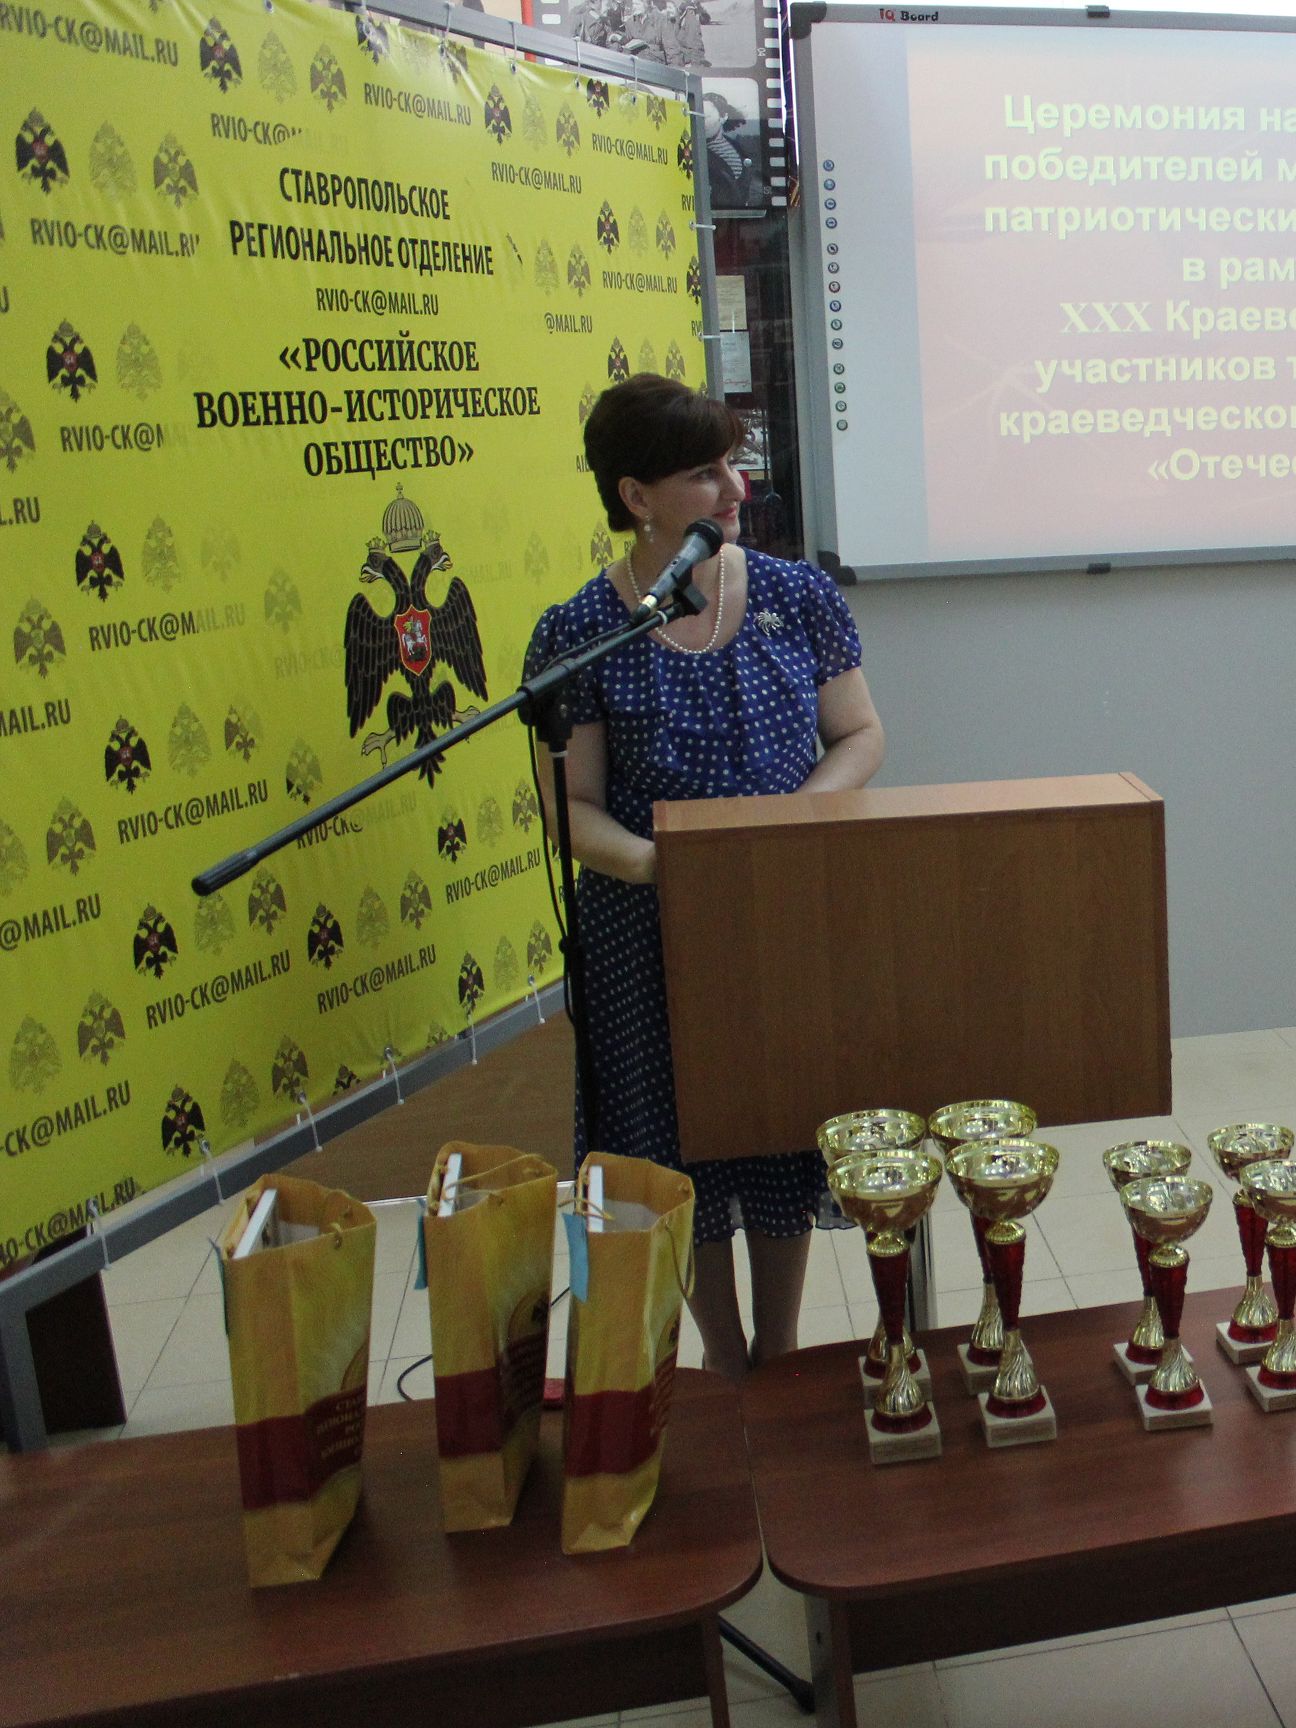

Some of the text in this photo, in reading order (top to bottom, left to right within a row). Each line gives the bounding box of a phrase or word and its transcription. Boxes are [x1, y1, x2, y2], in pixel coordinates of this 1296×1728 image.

[0, 2, 179, 68] RVIO-CK@MAIL.RU
[900, 10, 938, 21] Board
[364, 82, 472, 127] RVIO-CK@MAIL.RU
[1004, 94, 1245, 138] Церемония
[591, 132, 669, 166] RVIO-CK@MAIL.RU
[984, 146, 1263, 186] победителей
[279, 167, 450, 220] СТАВРОПОЛЬСКОЕ
[491, 161, 582, 195] RVIO-CK@MAIL.RU
[229, 219, 494, 277] РЕГИОНАЛЬНОЕ ОТДЕЛЕНИЕ
[1182, 257, 1206, 282] в
[315, 287, 439, 316] RVIO-CK@MAIL.RU
[602, 270, 678, 294] RVIO-CK@MAIL.RU
[279, 331, 480, 372] «РОССИЙСКОЕ
[1034, 353, 1276, 393] участников
[193, 386, 541, 428] ВОЕННО-ИСТОРИЧЕСКОЕ
[303, 433, 474, 480] ОБЩЕСТВО»
[117, 779, 269, 845] RVIO-CK@MAIL.RU
[445, 848, 541, 905] RVIO-CK@MAIL.RU
[146, 949, 291, 1030] RVIO-CK@MAIL.RU
[317, 944, 437, 1015] RVIO-CK@MAIL.RU
